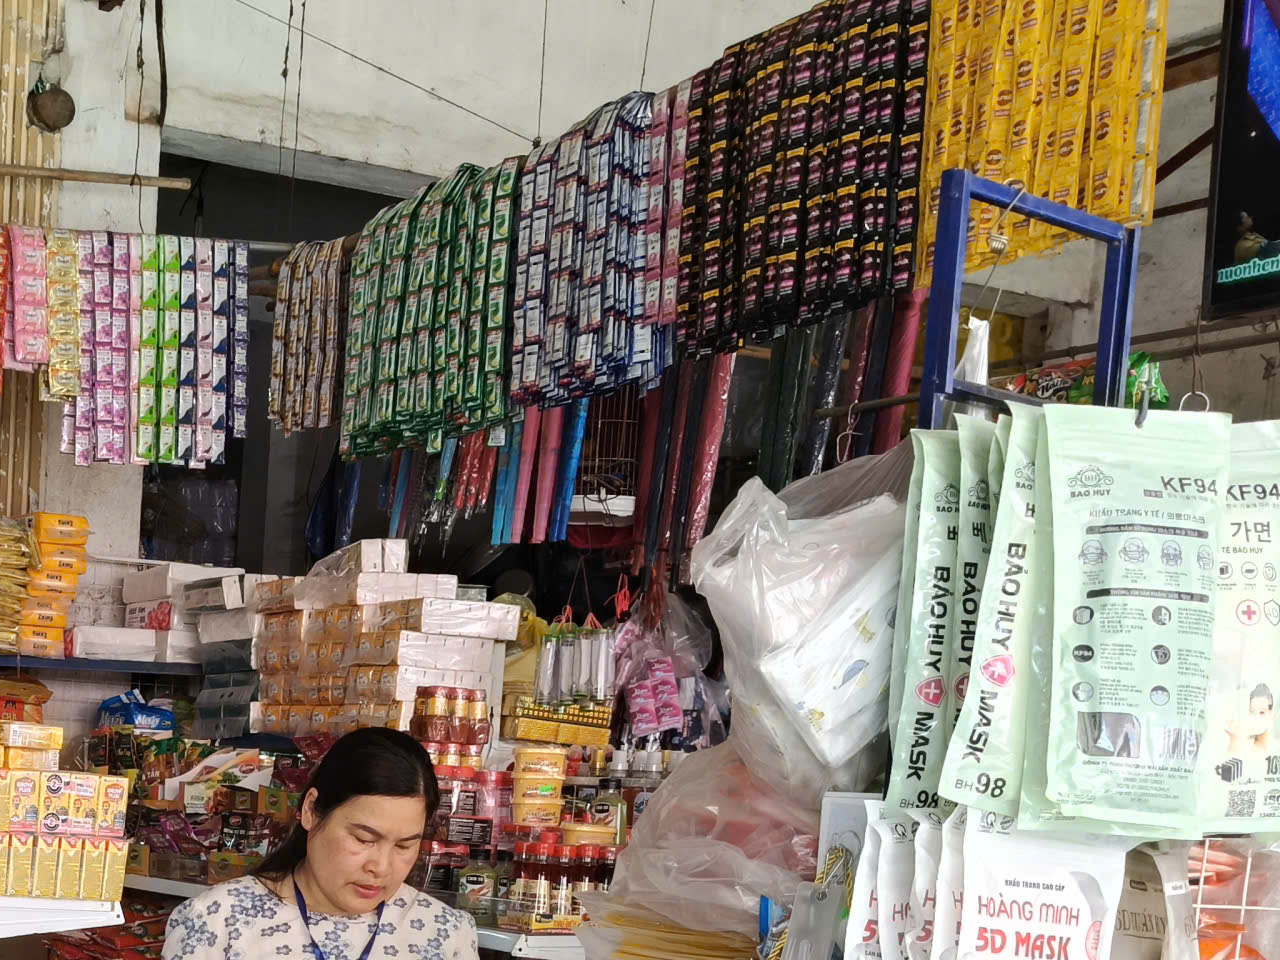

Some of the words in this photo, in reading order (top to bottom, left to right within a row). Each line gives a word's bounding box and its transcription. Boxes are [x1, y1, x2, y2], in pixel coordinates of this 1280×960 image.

[1092, 489, 1111, 497] HUY
[1160, 476, 1218, 496] KF94
[1230, 520, 1271, 543] 가면
[992, 599, 1017, 651] HUY
[924, 623, 946, 673] HUY
[962, 689, 998, 763] MASK
[906, 711, 937, 782] MASK
[955, 778, 974, 791] BH
[975, 772, 1007, 798] 98
[900, 798, 914, 809] BH
[978, 893, 1033, 921] HOÀNG
[1039, 902, 1080, 927] MINH
[975, 926, 1007, 954] 5D
